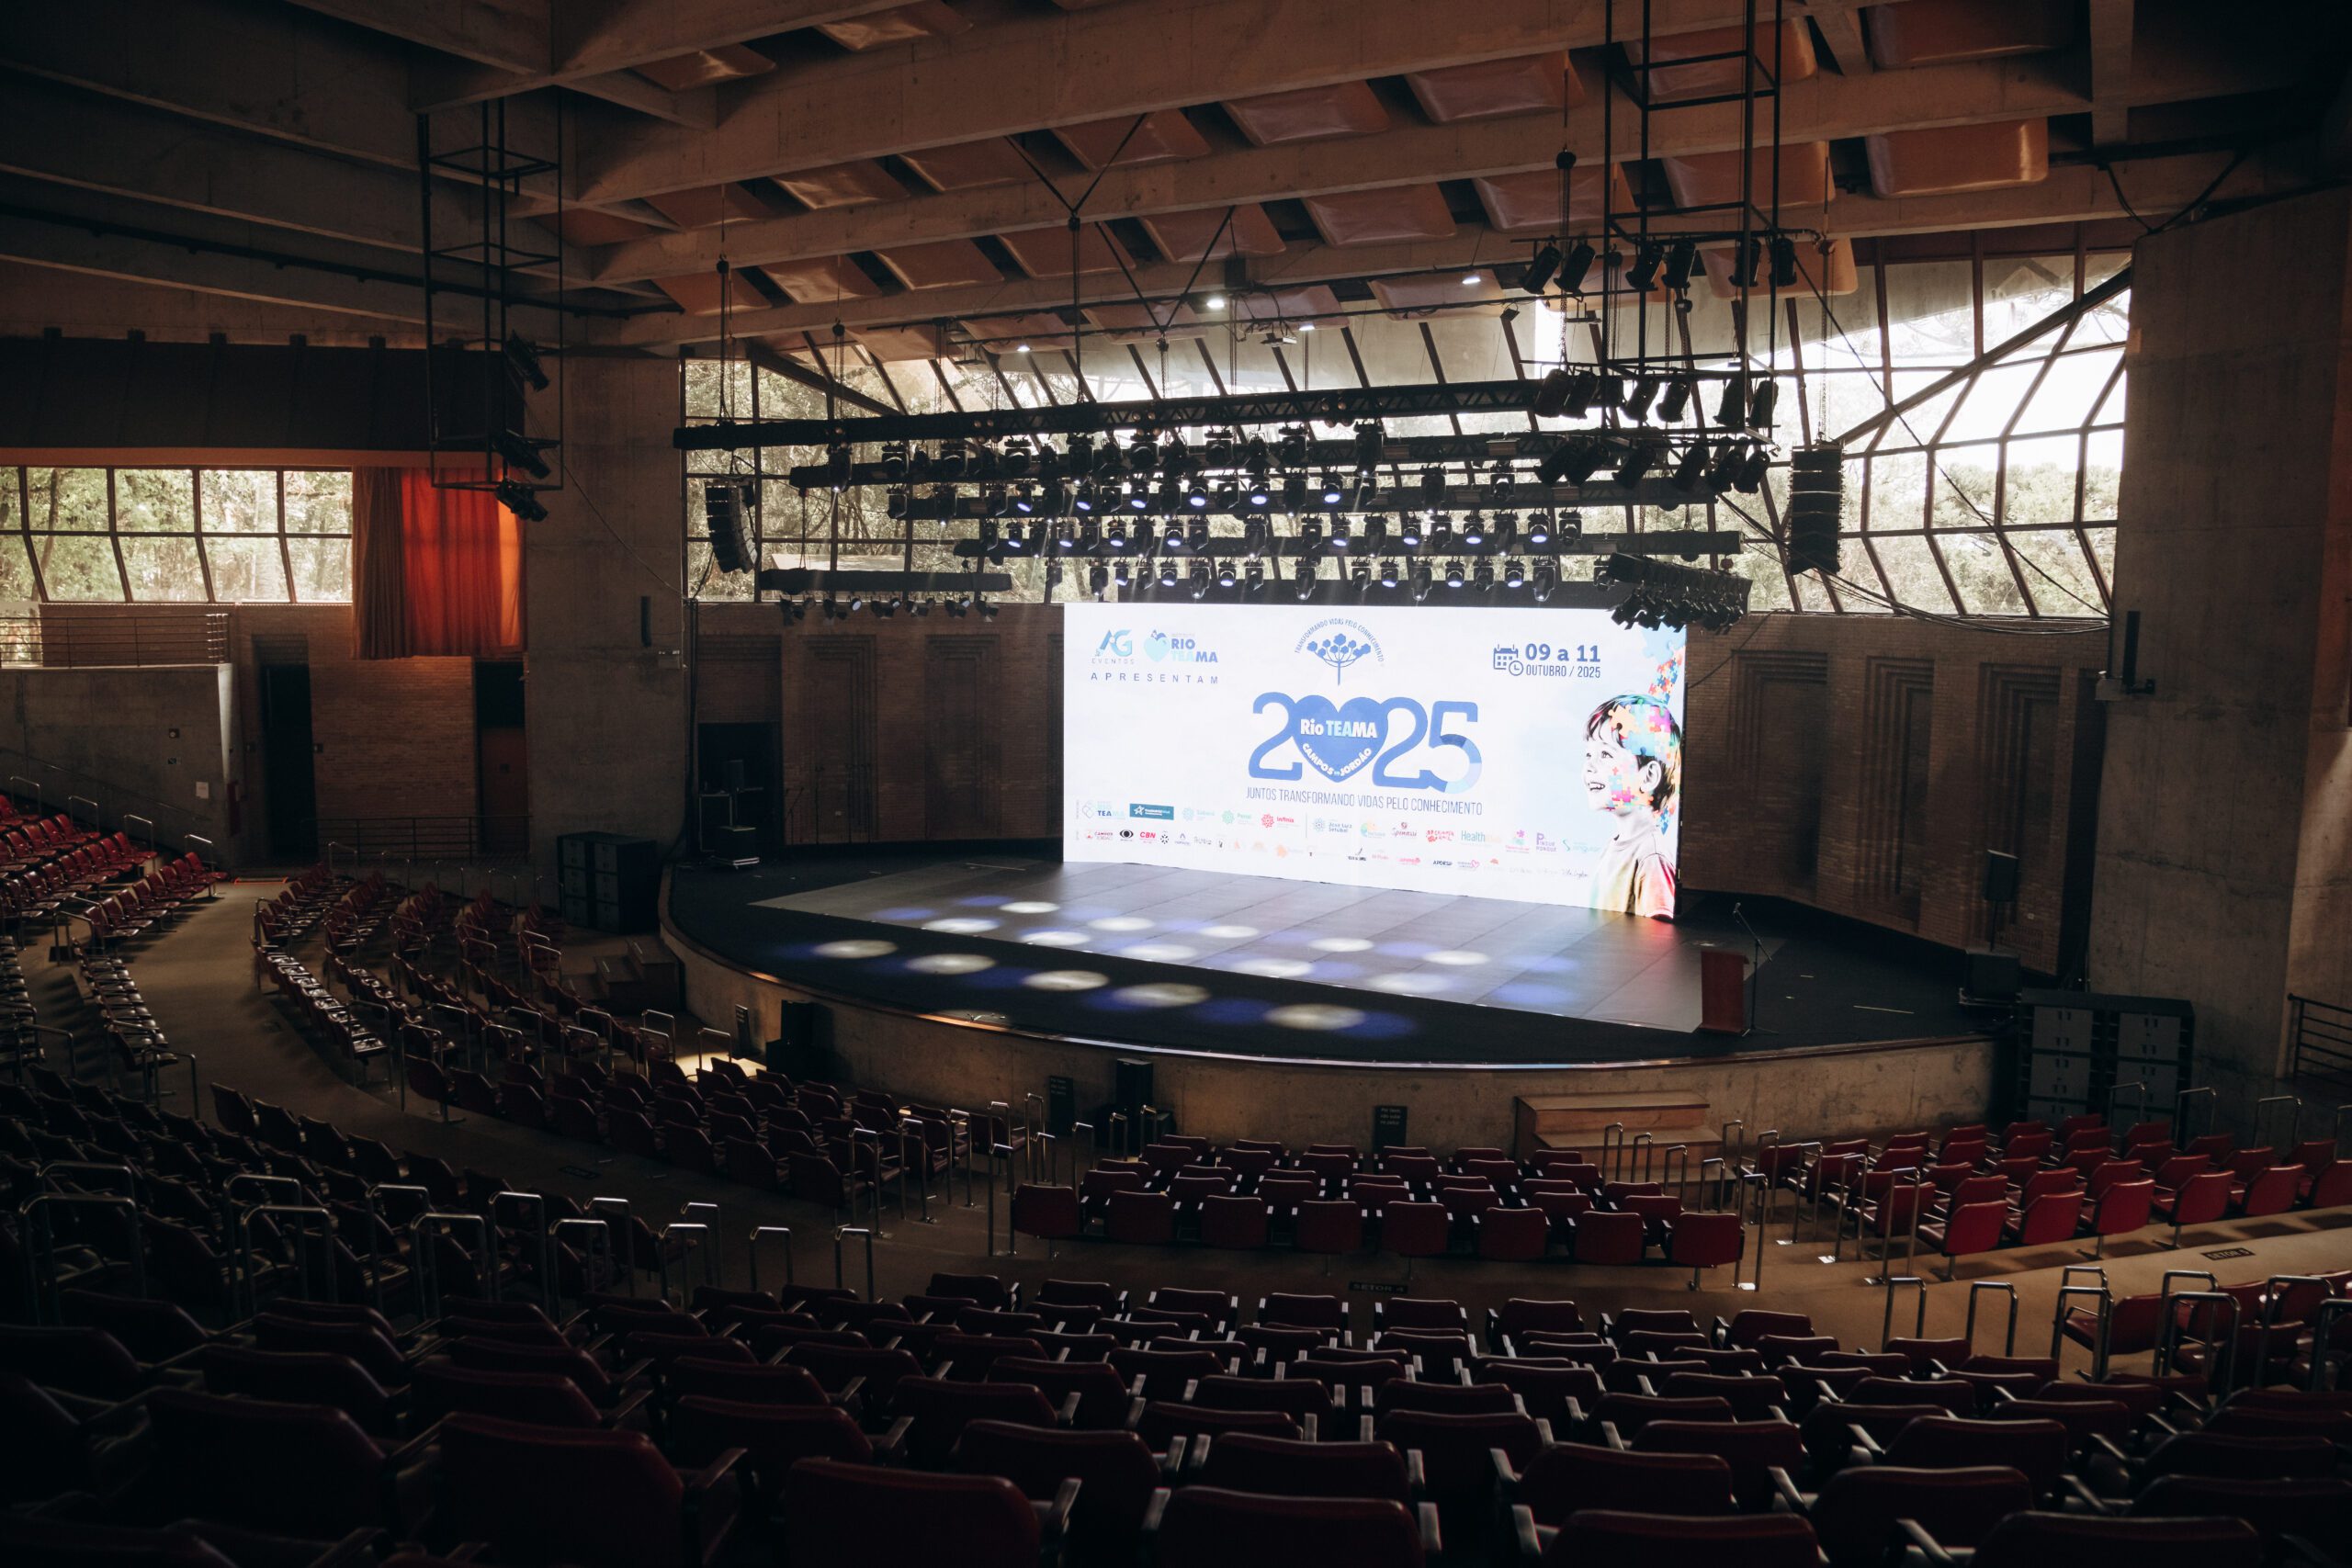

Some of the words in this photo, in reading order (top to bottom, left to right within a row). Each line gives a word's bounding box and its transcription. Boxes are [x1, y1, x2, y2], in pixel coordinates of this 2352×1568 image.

[1171, 638, 1195, 650] RIO
[1170, 650, 1218, 663] TEAMA
[1525, 643, 1551, 661] 09
[1557, 649, 1569, 661] a
[1577, 645, 1600, 663] 11
[1091, 672, 1218, 684] APRESENTAM
[1525, 664, 1567, 678] OUTUBRO
[1569, 665, 1575, 678] /
[1577, 665, 1600, 679] 2025
[1300, 718, 1324, 736] Rio
[1326, 720, 1378, 739] TEAMA
[1302, 742, 1334, 775] CAMPOS
[1340, 747, 1373, 777] JORDÃO
[1246, 786, 1277, 801] JUNTOS
[1279, 788, 1354, 807] TRANSFORMANDO
[1358, 795, 1384, 809] VIDAS
[1385, 797, 1409, 810] PELO
[1411, 799, 1483, 816] CONHECIMENTO
